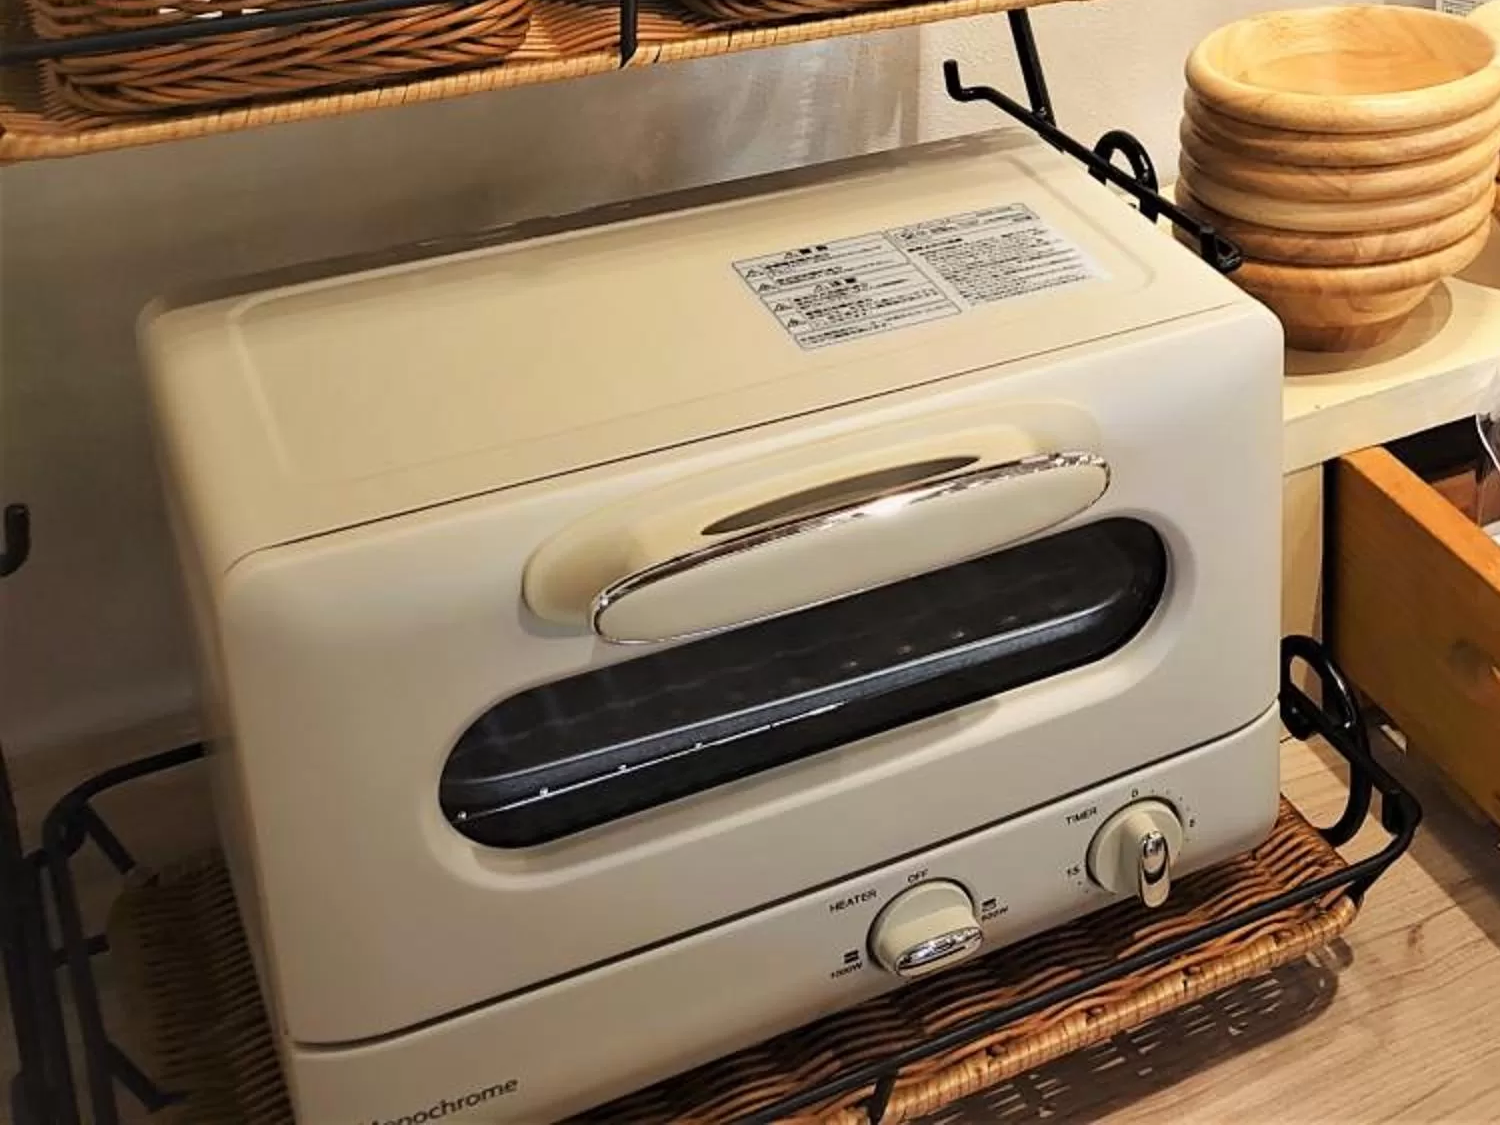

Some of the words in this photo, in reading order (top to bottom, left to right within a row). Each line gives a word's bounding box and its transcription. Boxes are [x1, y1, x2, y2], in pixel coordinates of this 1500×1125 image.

[1066, 806, 1097, 825] TIMER
[907, 869, 929, 884] OFF
[829, 888, 877, 913] HEATER
[372, 1078, 518, 1125] nochrome
